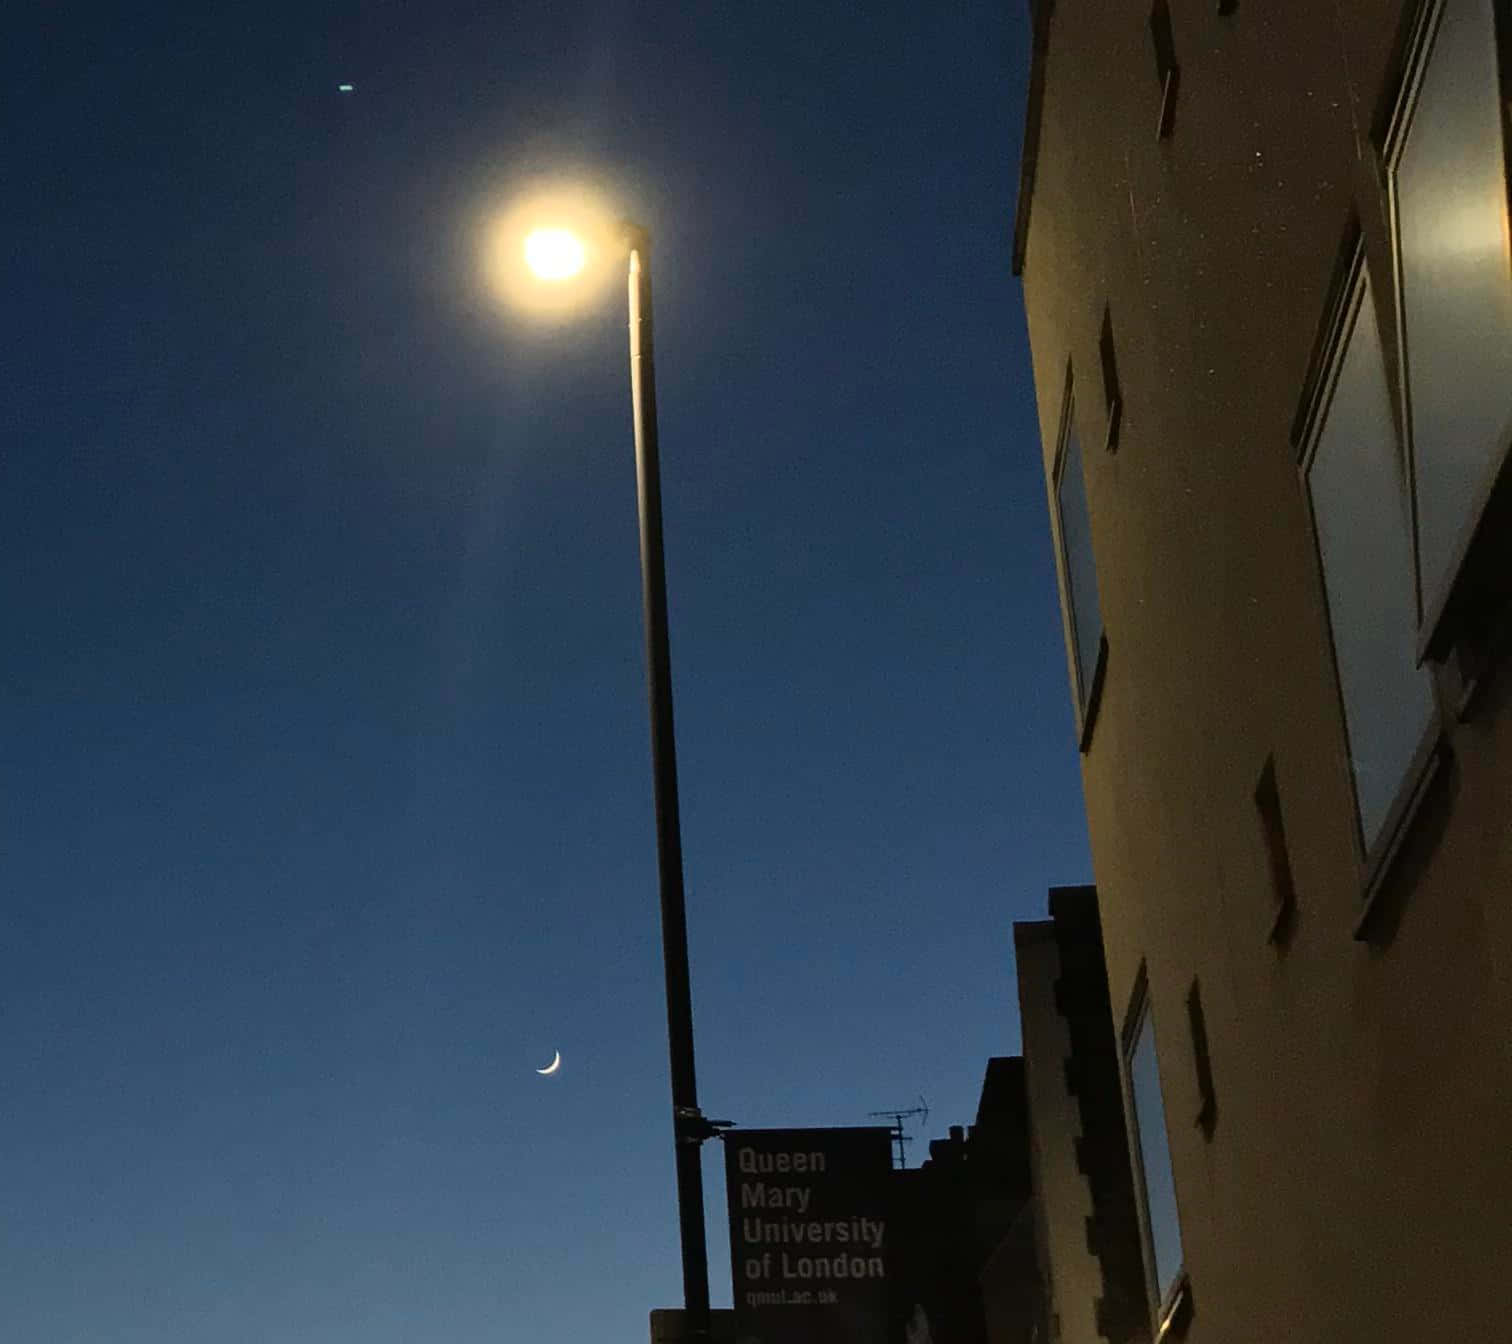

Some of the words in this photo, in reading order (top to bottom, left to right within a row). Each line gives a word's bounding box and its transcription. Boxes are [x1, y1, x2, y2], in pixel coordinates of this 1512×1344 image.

[738, 1146, 826, 1174] Queen
[741, 1182, 811, 1213] Mary
[743, 1216, 885, 1248] University
[745, 1253, 771, 1279] of
[782, 1252, 885, 1279] London
